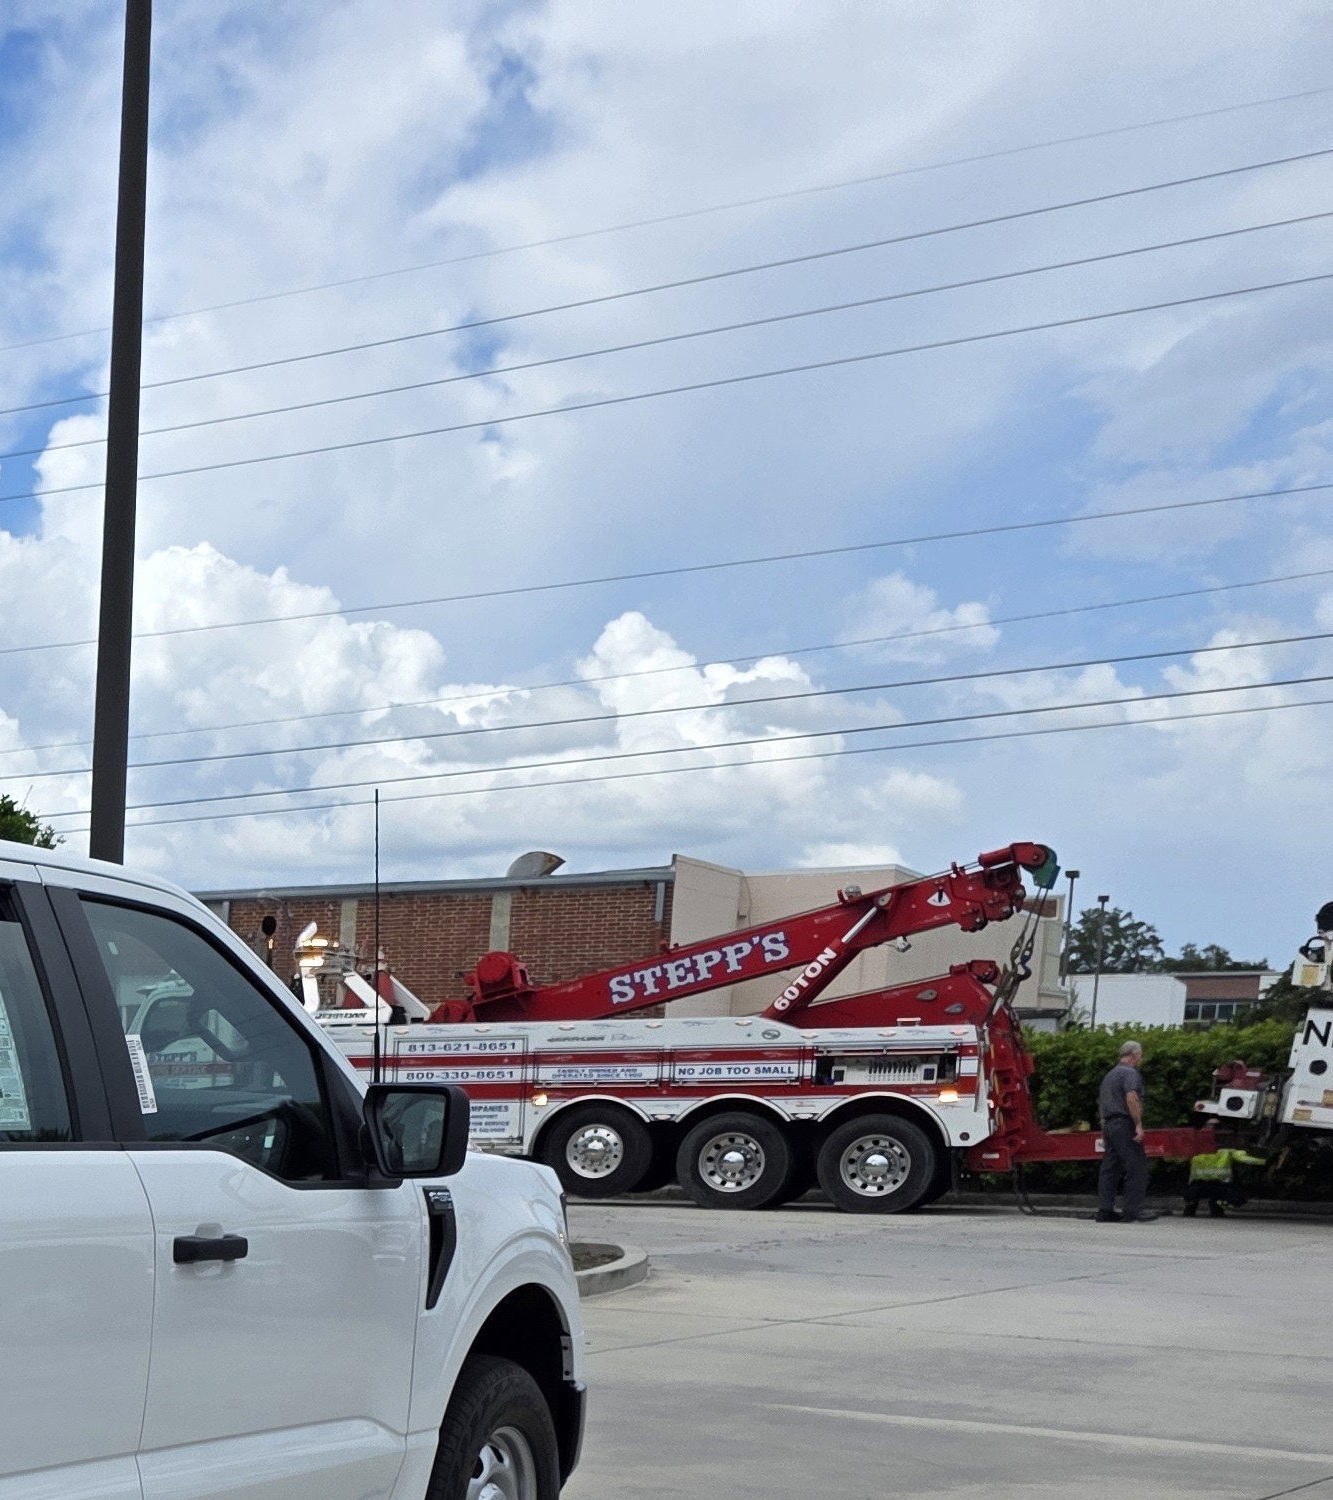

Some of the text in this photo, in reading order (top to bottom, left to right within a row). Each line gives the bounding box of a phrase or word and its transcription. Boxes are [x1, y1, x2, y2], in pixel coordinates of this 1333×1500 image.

[608, 931, 791, 1005] STEPP'S
[1302, 1019, 1333, 1048] N
[678, 1066, 794, 1076] NO JOB TOO SMALL
